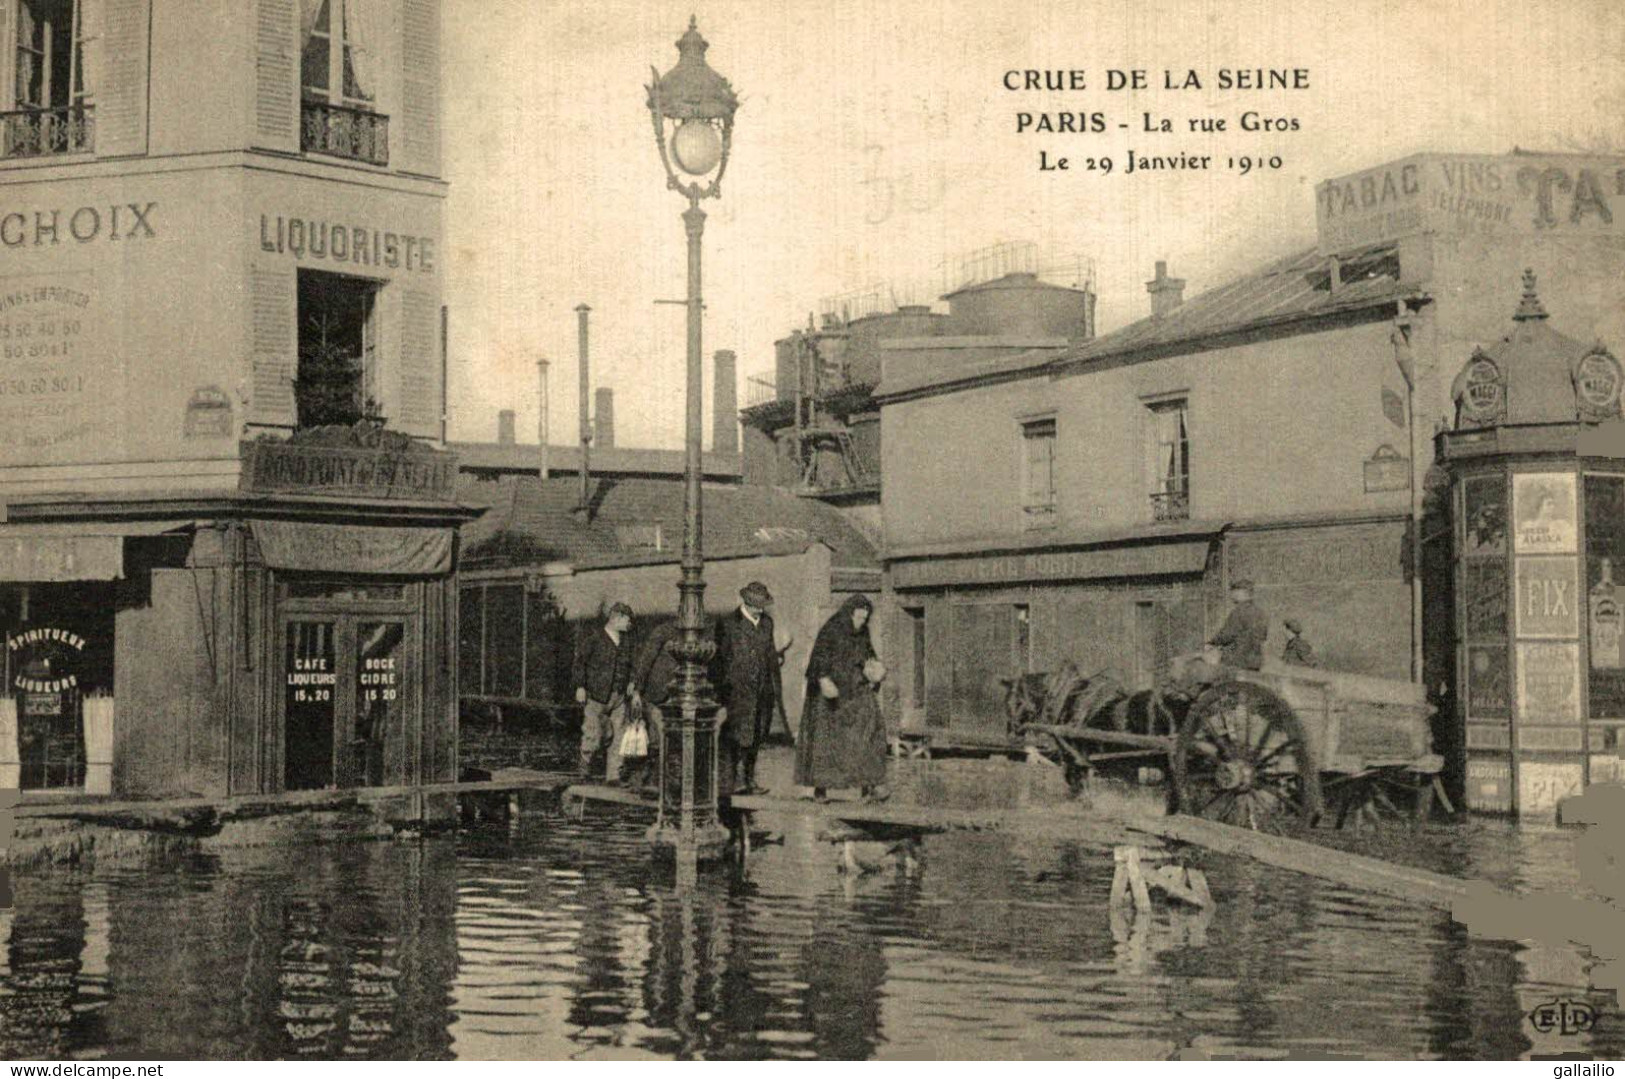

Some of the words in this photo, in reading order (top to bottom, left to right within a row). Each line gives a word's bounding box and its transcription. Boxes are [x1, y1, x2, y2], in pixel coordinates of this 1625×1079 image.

[1442, 162, 1502, 192] VINS
[1320, 163, 1420, 219] TABAC
[0, 201, 158, 247] CHOIX
[260, 214, 435, 272] LIQUORISTE
[1527, 579, 1569, 617] FIX
[9, 628, 86, 651] SPIRITUEUX
[295, 659, 326, 671] CAFE
[366, 659, 396, 670] BOCK
[15, 675, 77, 693] LIQUEURS
[287, 673, 336, 685] LIQUEURS
[361, 673, 396, 685] CIDRE
